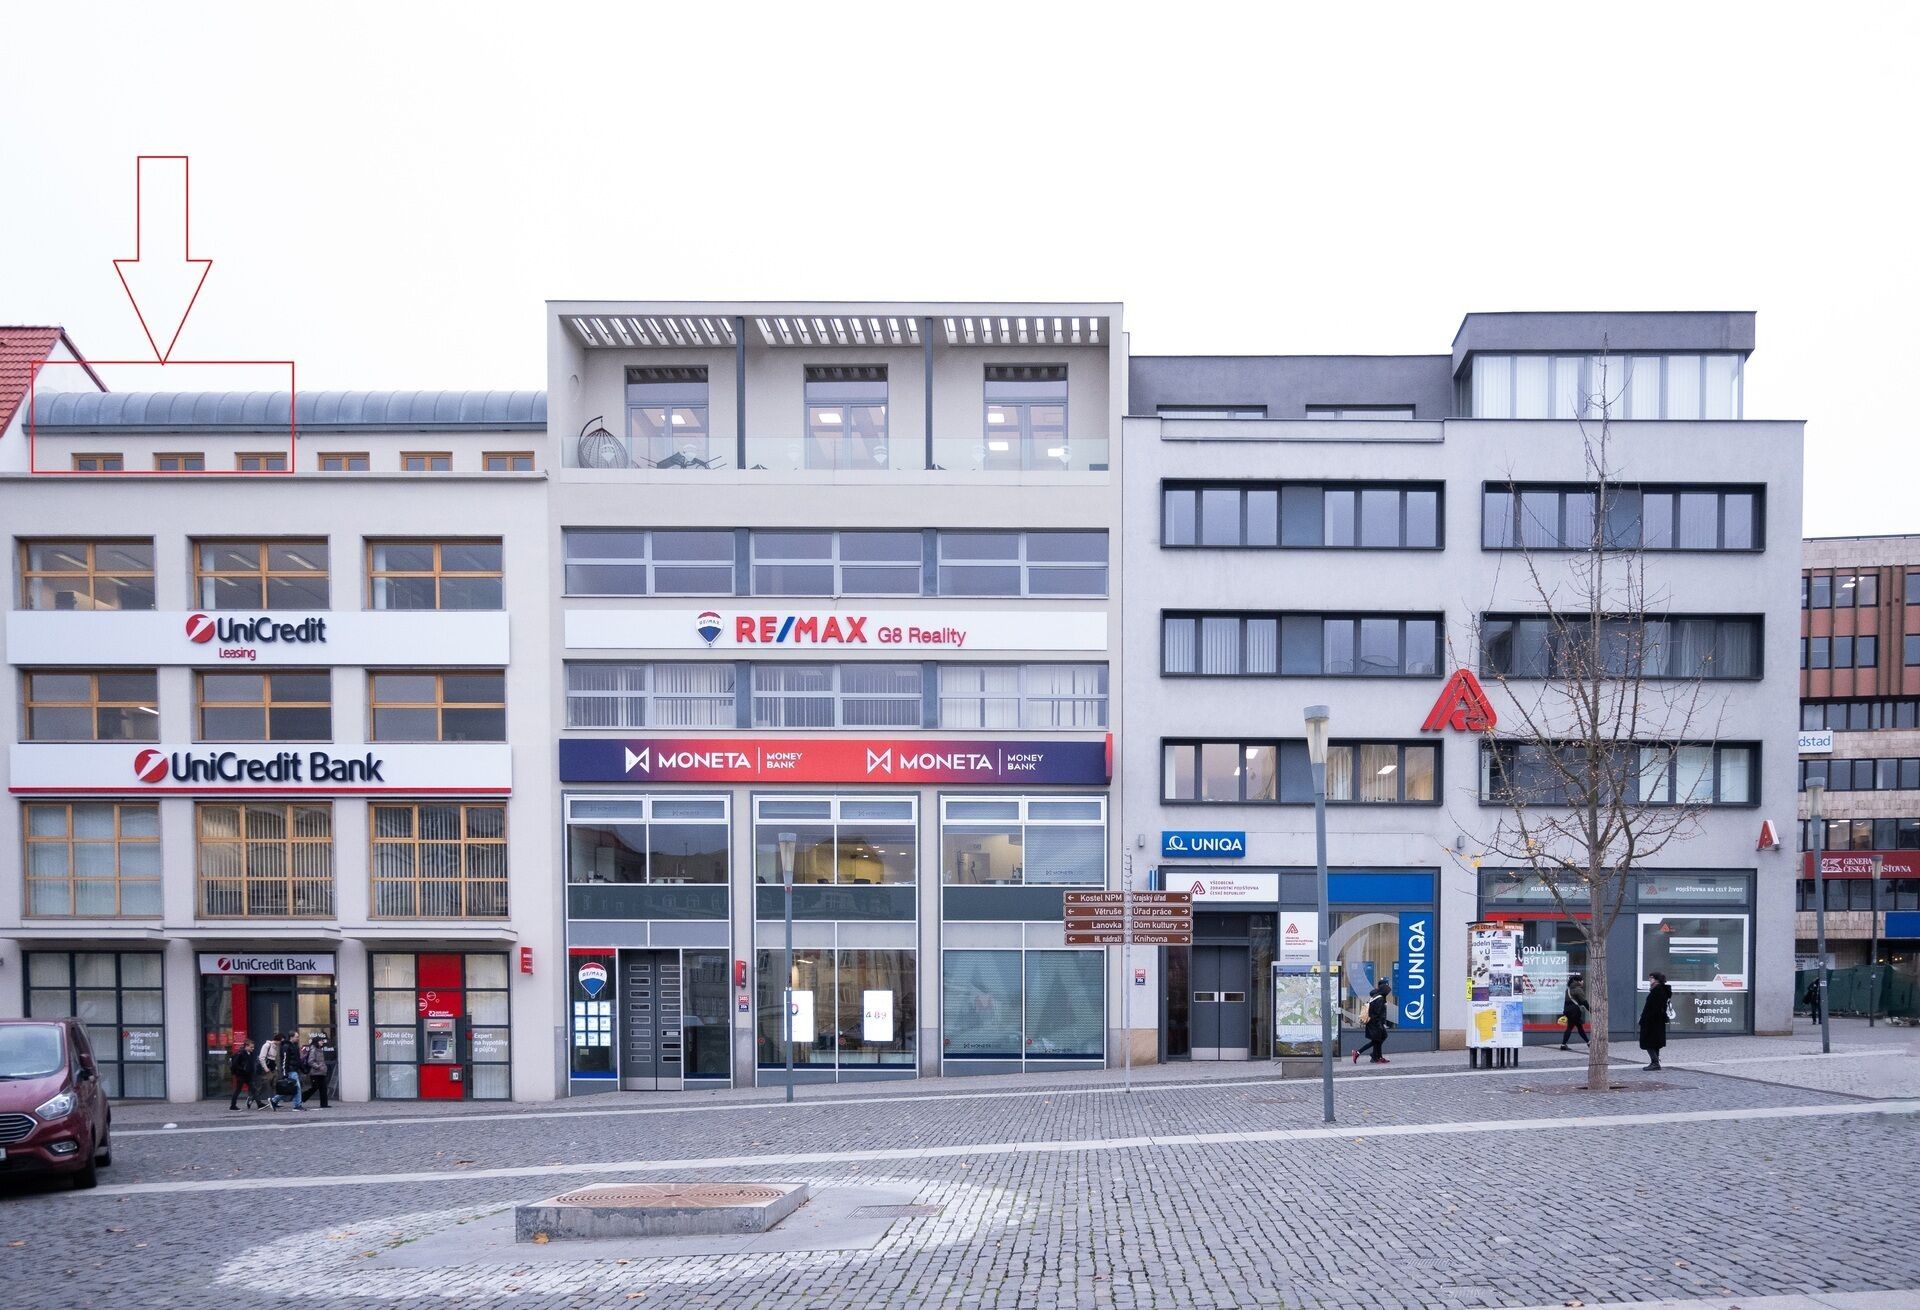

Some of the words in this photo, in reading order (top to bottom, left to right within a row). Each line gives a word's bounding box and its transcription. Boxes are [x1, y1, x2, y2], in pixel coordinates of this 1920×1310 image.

[217, 617, 327, 643] UniCredit
[736, 616, 867, 643] RE/MAX
[878, 627, 902, 643] G8
[909, 627, 966, 647] Reality
[219, 648, 257, 661] Leasing
[658, 752, 751, 769] MONETA
[766, 752, 803, 760] MONEY
[1007, 754, 1044, 762] MONEY
[766, 761, 795, 769] BANK
[900, 753, 993, 770] MONETA
[172, 751, 302, 782] UniCredit
[309, 751, 384, 782] Bank
[1191, 838, 1243, 851] UNIQA
[1843, 864, 1866, 873] ČESKÁ
[1868, 864, 1912, 873] PIŠŤOVNA
[1080, 892, 1103, 902] Kostel
[1105, 892, 1122, 901] NPM
[1132, 894, 1153, 903] Krajský
[1094, 907, 1122, 915] Větruše
[1133, 906, 1151, 915] Úřad
[1152, 907, 1172, 917] práce
[1091, 921, 1122, 929] Lanovka
[1152, 920, 1177, 930] kultury
[1134, 935, 1167, 943] Knihovna
[1408, 920, 1426, 990] UNIQA
[232, 959, 284, 971] UniCredit
[287, 959, 316, 971] Bank
[1551, 957, 1567, 965] VZP
[1694, 998, 1712, 1006] Ryze
[1713, 997, 1733, 1005] česká
[1697, 1006, 1730, 1014] komerční
[1694, 1015, 1733, 1024] pojišťovna
